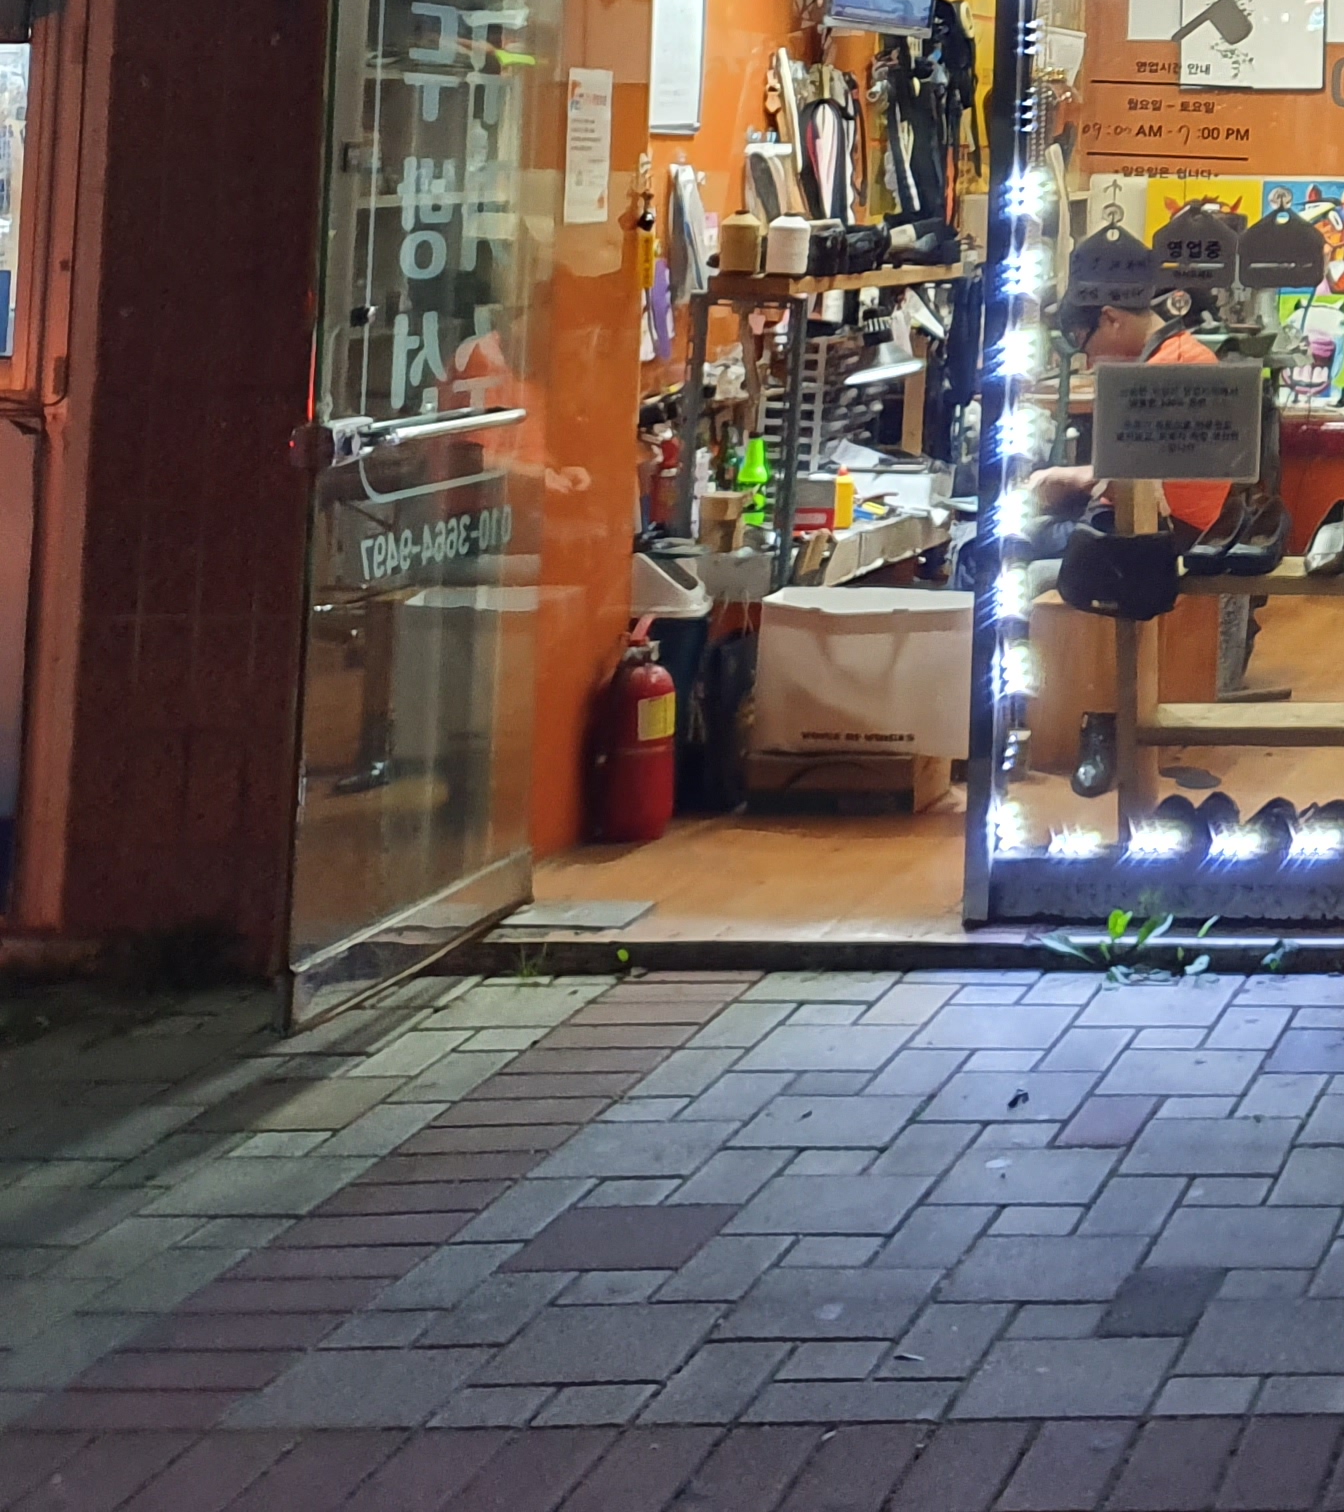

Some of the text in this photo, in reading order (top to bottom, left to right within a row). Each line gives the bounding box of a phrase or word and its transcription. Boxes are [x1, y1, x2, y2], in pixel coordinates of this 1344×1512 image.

[1186, 63, 1212, 76] 안내
[1179, 99, 1216, 115] 토요일
[1135, 125, 1163, 138] AM
[1225, 127, 1250, 140] PM
[1167, 239, 1222, 259] 영업중
